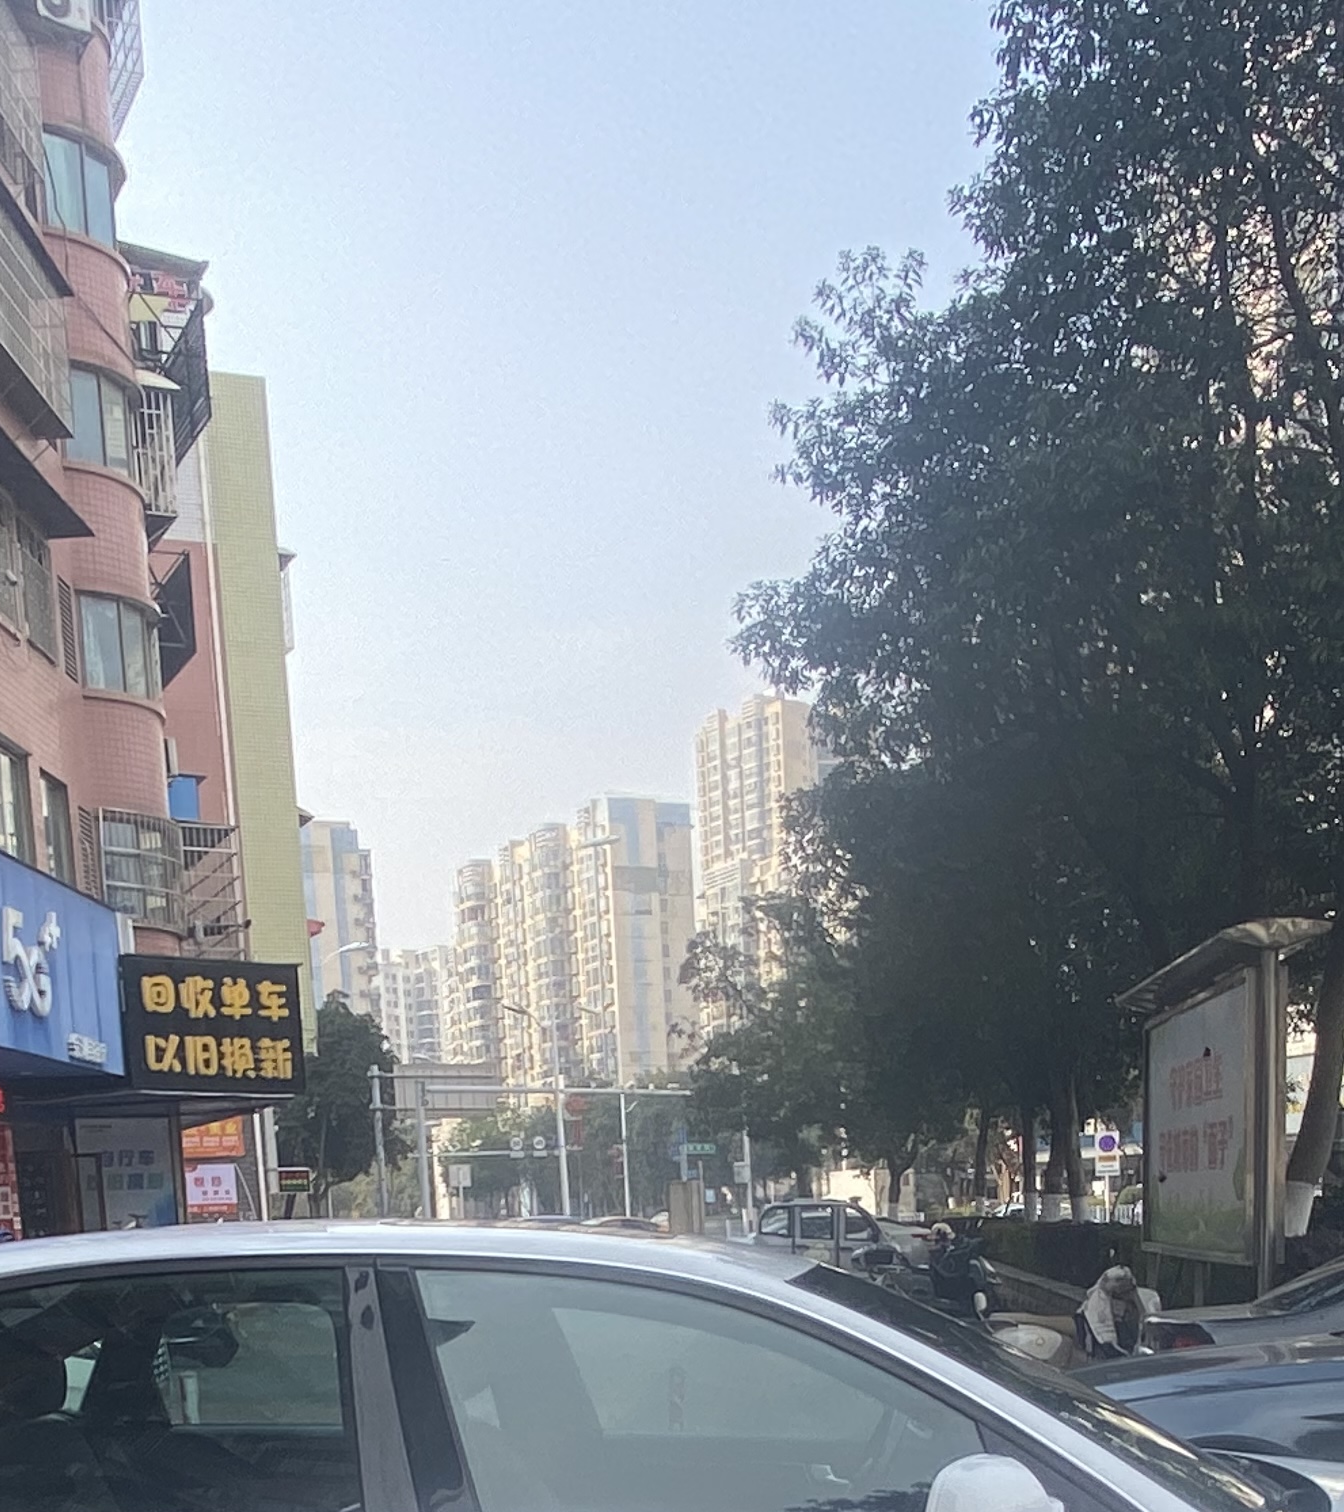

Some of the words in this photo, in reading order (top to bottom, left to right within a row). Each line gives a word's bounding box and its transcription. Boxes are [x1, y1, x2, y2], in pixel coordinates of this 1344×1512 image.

[140, 975, 290, 1021] 回收单车
[144, 1034, 293, 1080] 以旧换新
